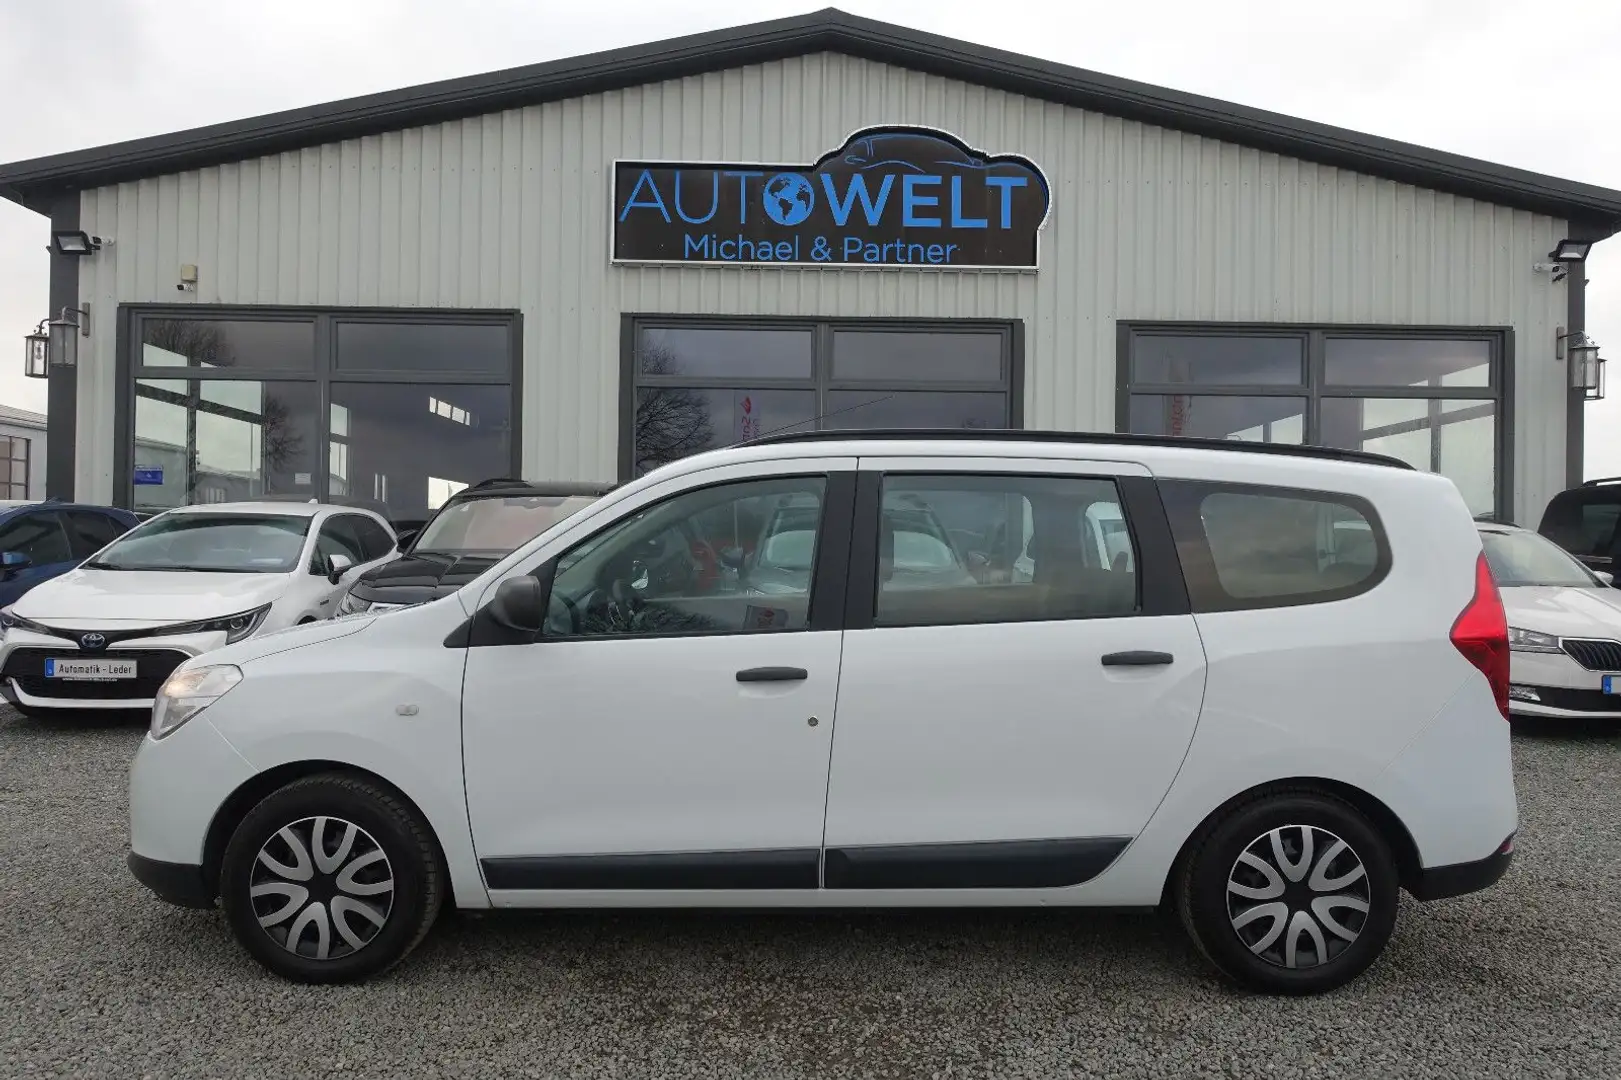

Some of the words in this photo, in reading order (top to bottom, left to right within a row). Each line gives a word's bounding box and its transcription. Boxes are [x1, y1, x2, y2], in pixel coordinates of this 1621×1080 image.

[684, 234, 799, 261] Michael
[811, 237, 832, 261] &
[844, 236, 957, 263] Partner
[58, 664, 100, 674] Automatik
[108, 664, 132, 674] Leder
